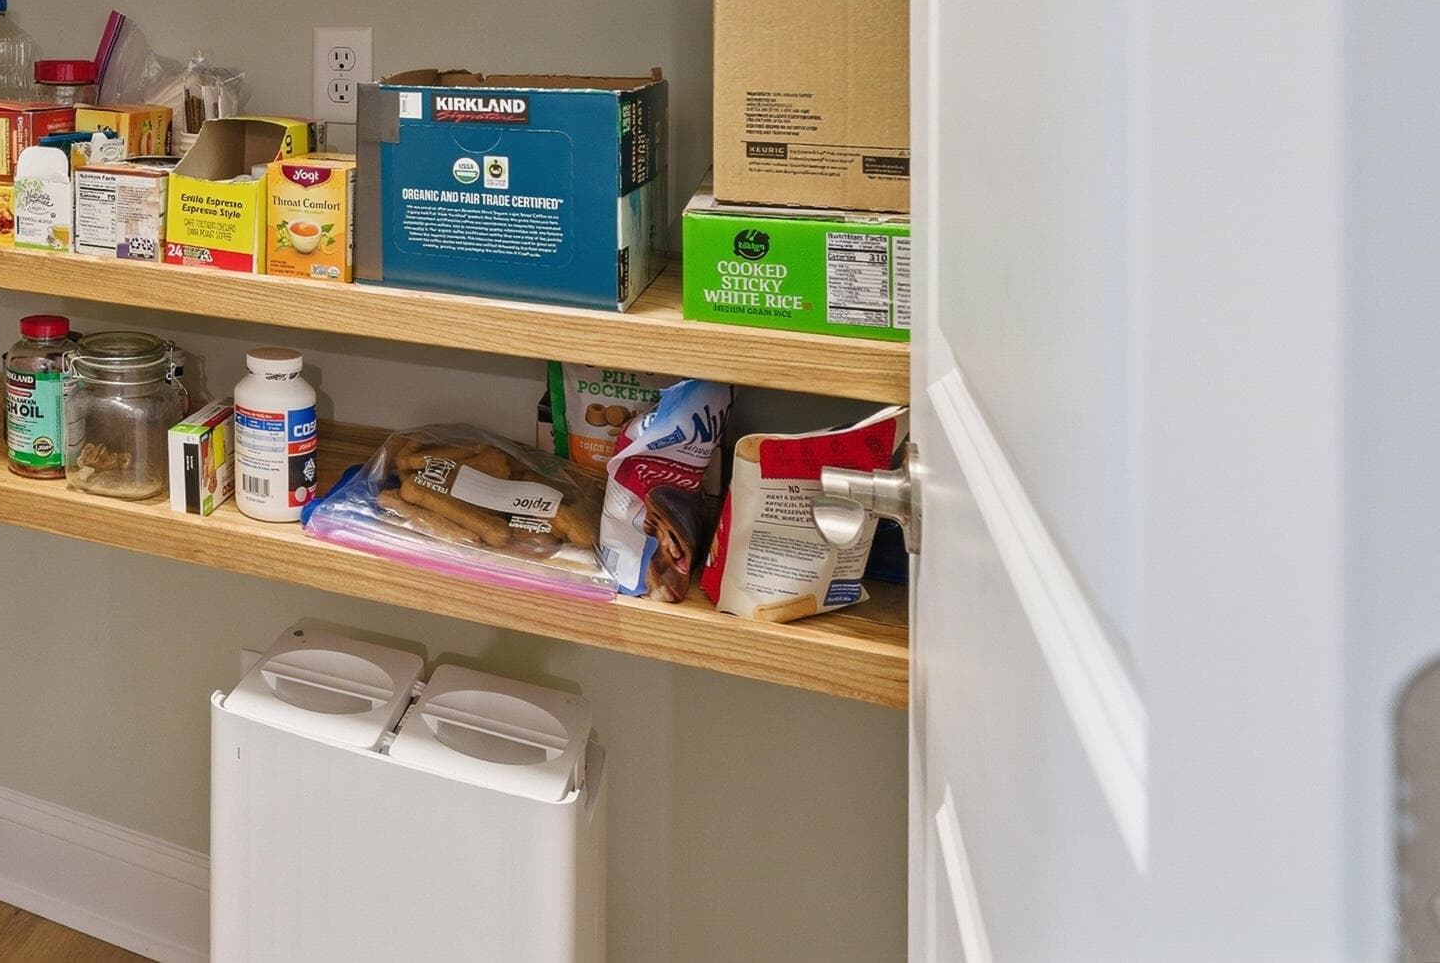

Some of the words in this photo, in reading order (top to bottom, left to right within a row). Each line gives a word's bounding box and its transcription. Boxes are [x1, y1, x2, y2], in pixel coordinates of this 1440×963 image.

[435, 96, 526, 114] KIRKLAND
[206, 196, 243, 209] Espresso
[272, 195, 301, 207] Throat
[303, 200, 341, 212] Comfort
[402, 188, 439, 202] ORGANIC
[440, 190, 459, 204] AND
[460, 192, 480, 206] FAIR
[480, 193, 511, 208] TRADE
[182, 204, 217, 216] Espresso
[864, 234, 888, 243] Facts
[167, 244, 183, 258] 24
[868, 253, 888, 263] 310
[717, 260, 788, 279] COOKED
[721, 275, 783, 293] STICKY
[703, 289, 760, 307] WHITE
[765, 295, 803, 311] RICE
[747, 308, 772, 317] GRAIN
[773, 310, 793, 319] RICE
[602, 369, 640, 387] PILL
[577, 379, 661, 403] POCKETS
[20, 404, 45, 418] OIL
[788, 485, 800, 494] NO
[512, 497, 552, 513] Ziploc
